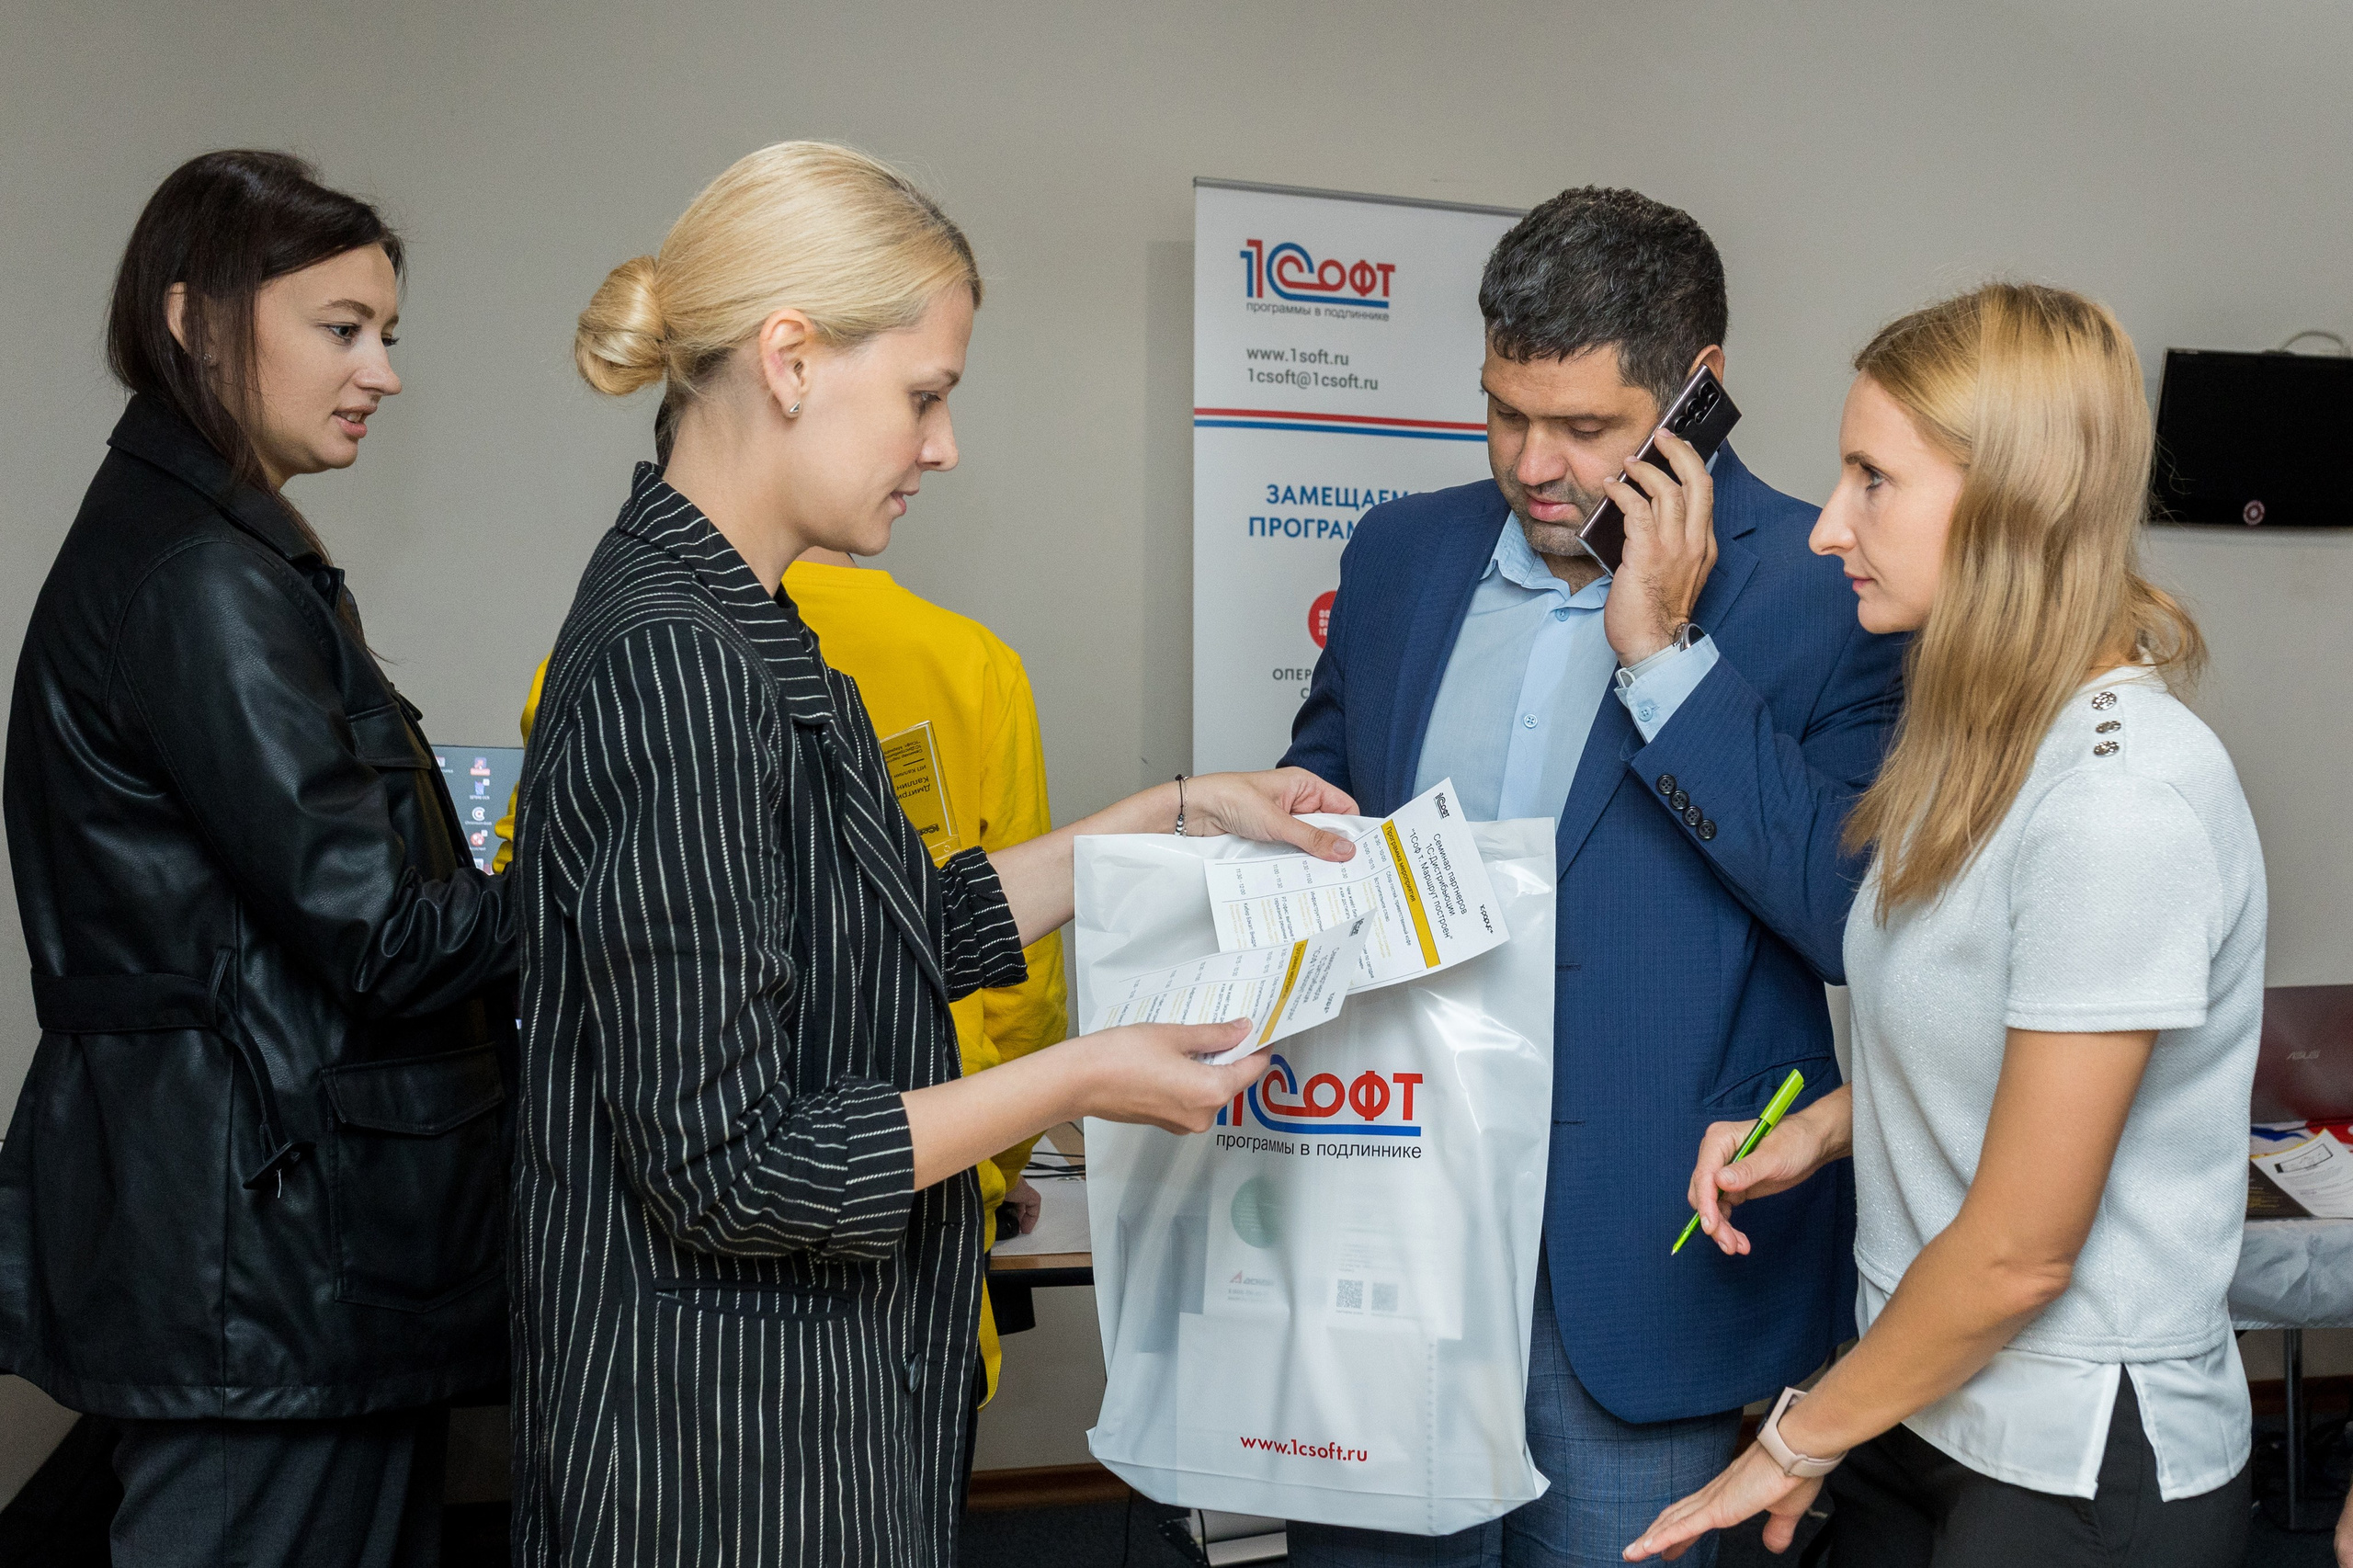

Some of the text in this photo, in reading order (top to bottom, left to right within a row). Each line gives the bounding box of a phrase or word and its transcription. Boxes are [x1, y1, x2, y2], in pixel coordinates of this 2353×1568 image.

[1246, 301, 1390, 322] программы в подлиннике
[1246, 347, 1348, 366] www.1soft.ru
[1247, 368, 1379, 391] 1csoft@1csoft.ru
[896, 776, 929, 790] Каплин
[1384, 825, 1417, 902] Программа мероприятия
[1432, 833, 1452, 871] Семинар
[1446, 870, 1468, 915] партнеров
[1417, 862, 1438, 901] Маршрут
[1424, 842, 1456, 916] 1С:Дистрибьюции
[1216, 1134, 1422, 1159] программы в подлиннике
[1240, 1437, 1368, 1461] www.1csoft.ru
